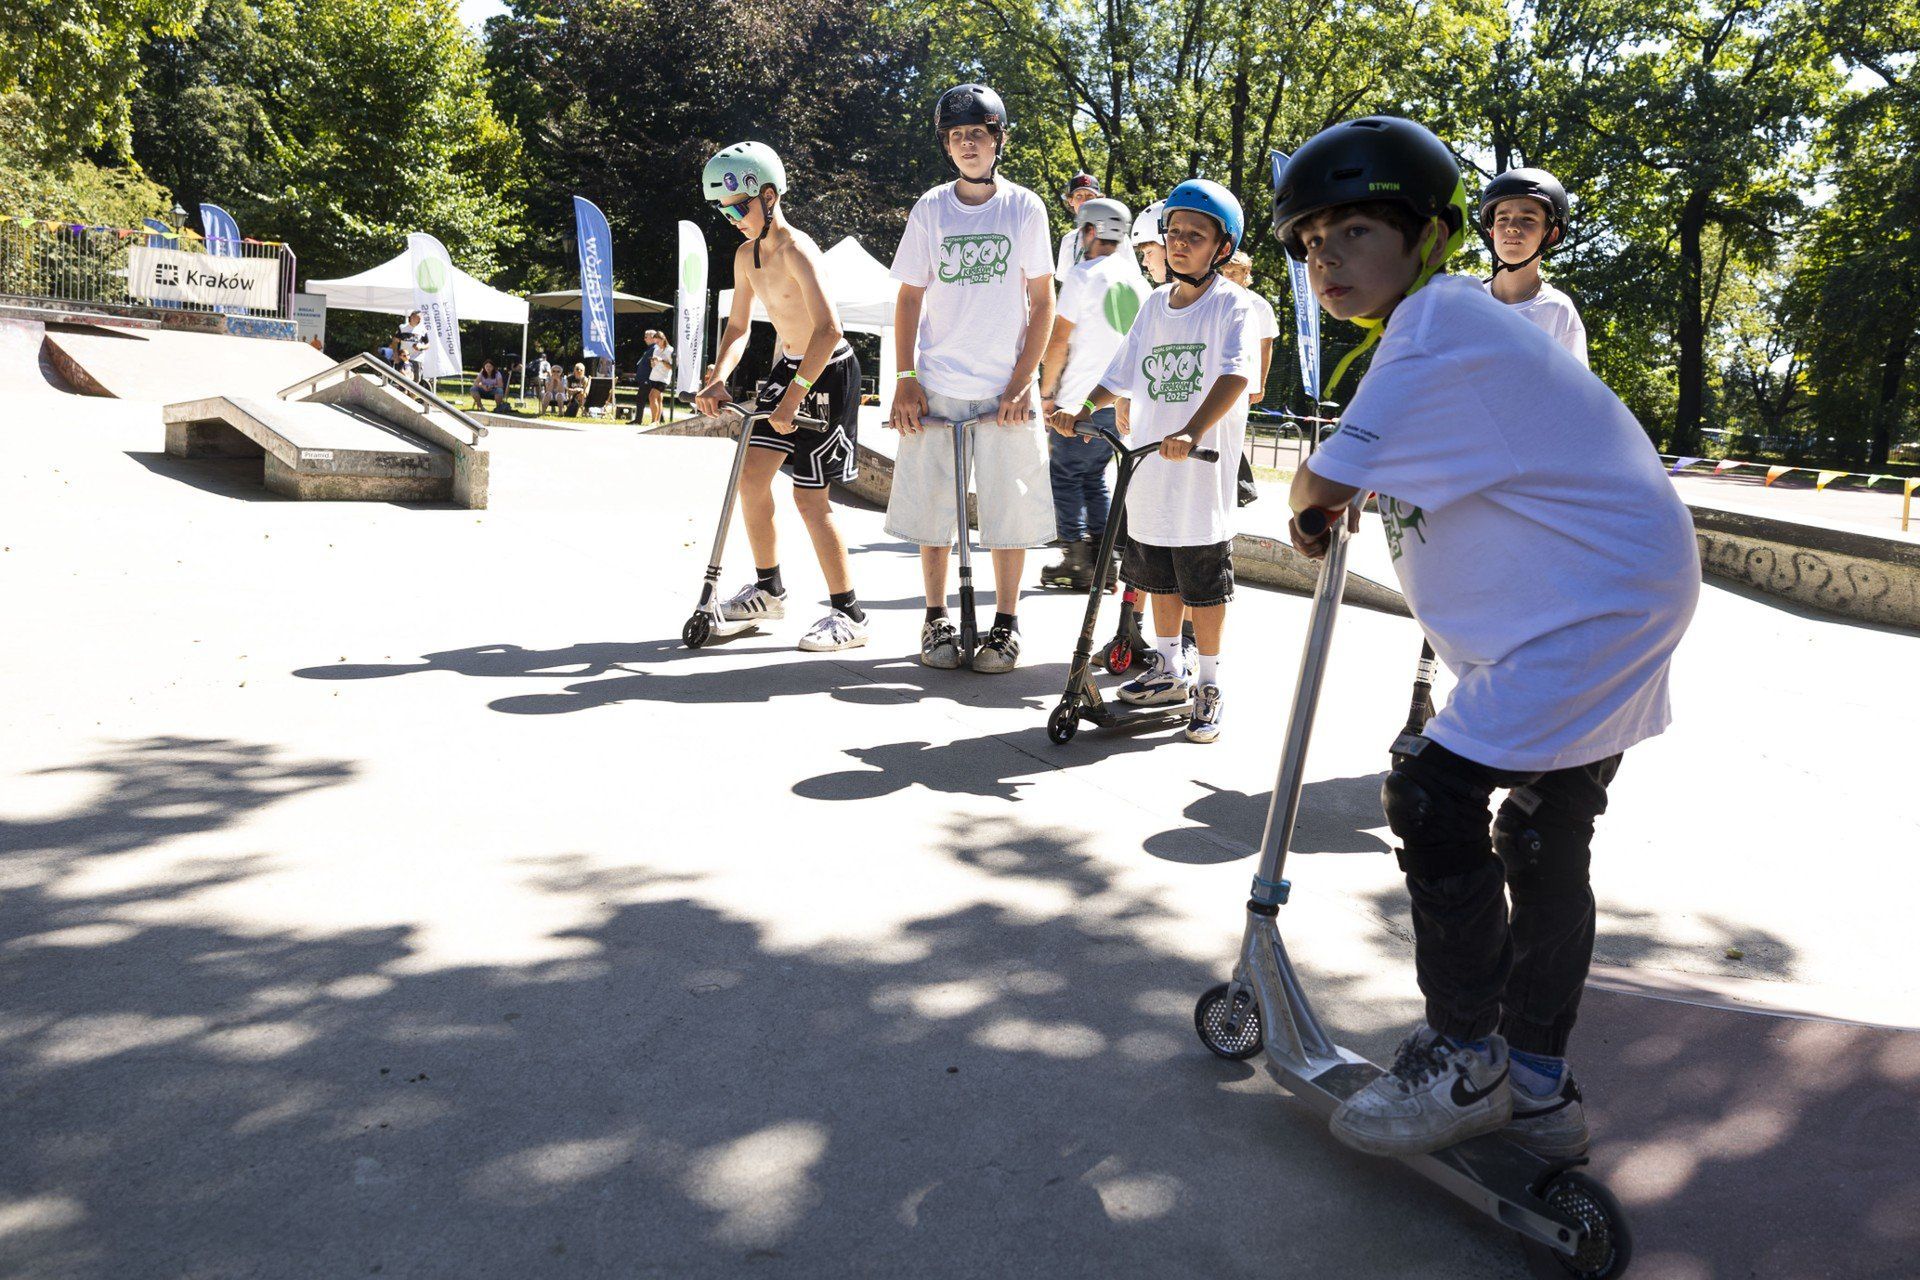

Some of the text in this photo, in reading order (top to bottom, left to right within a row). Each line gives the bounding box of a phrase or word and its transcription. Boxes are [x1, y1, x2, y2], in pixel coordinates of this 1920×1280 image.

[1369, 182, 1400, 191] BTWIN
[186, 269, 255, 291] Kraków
[1166, 392, 1188, 401] 2025
